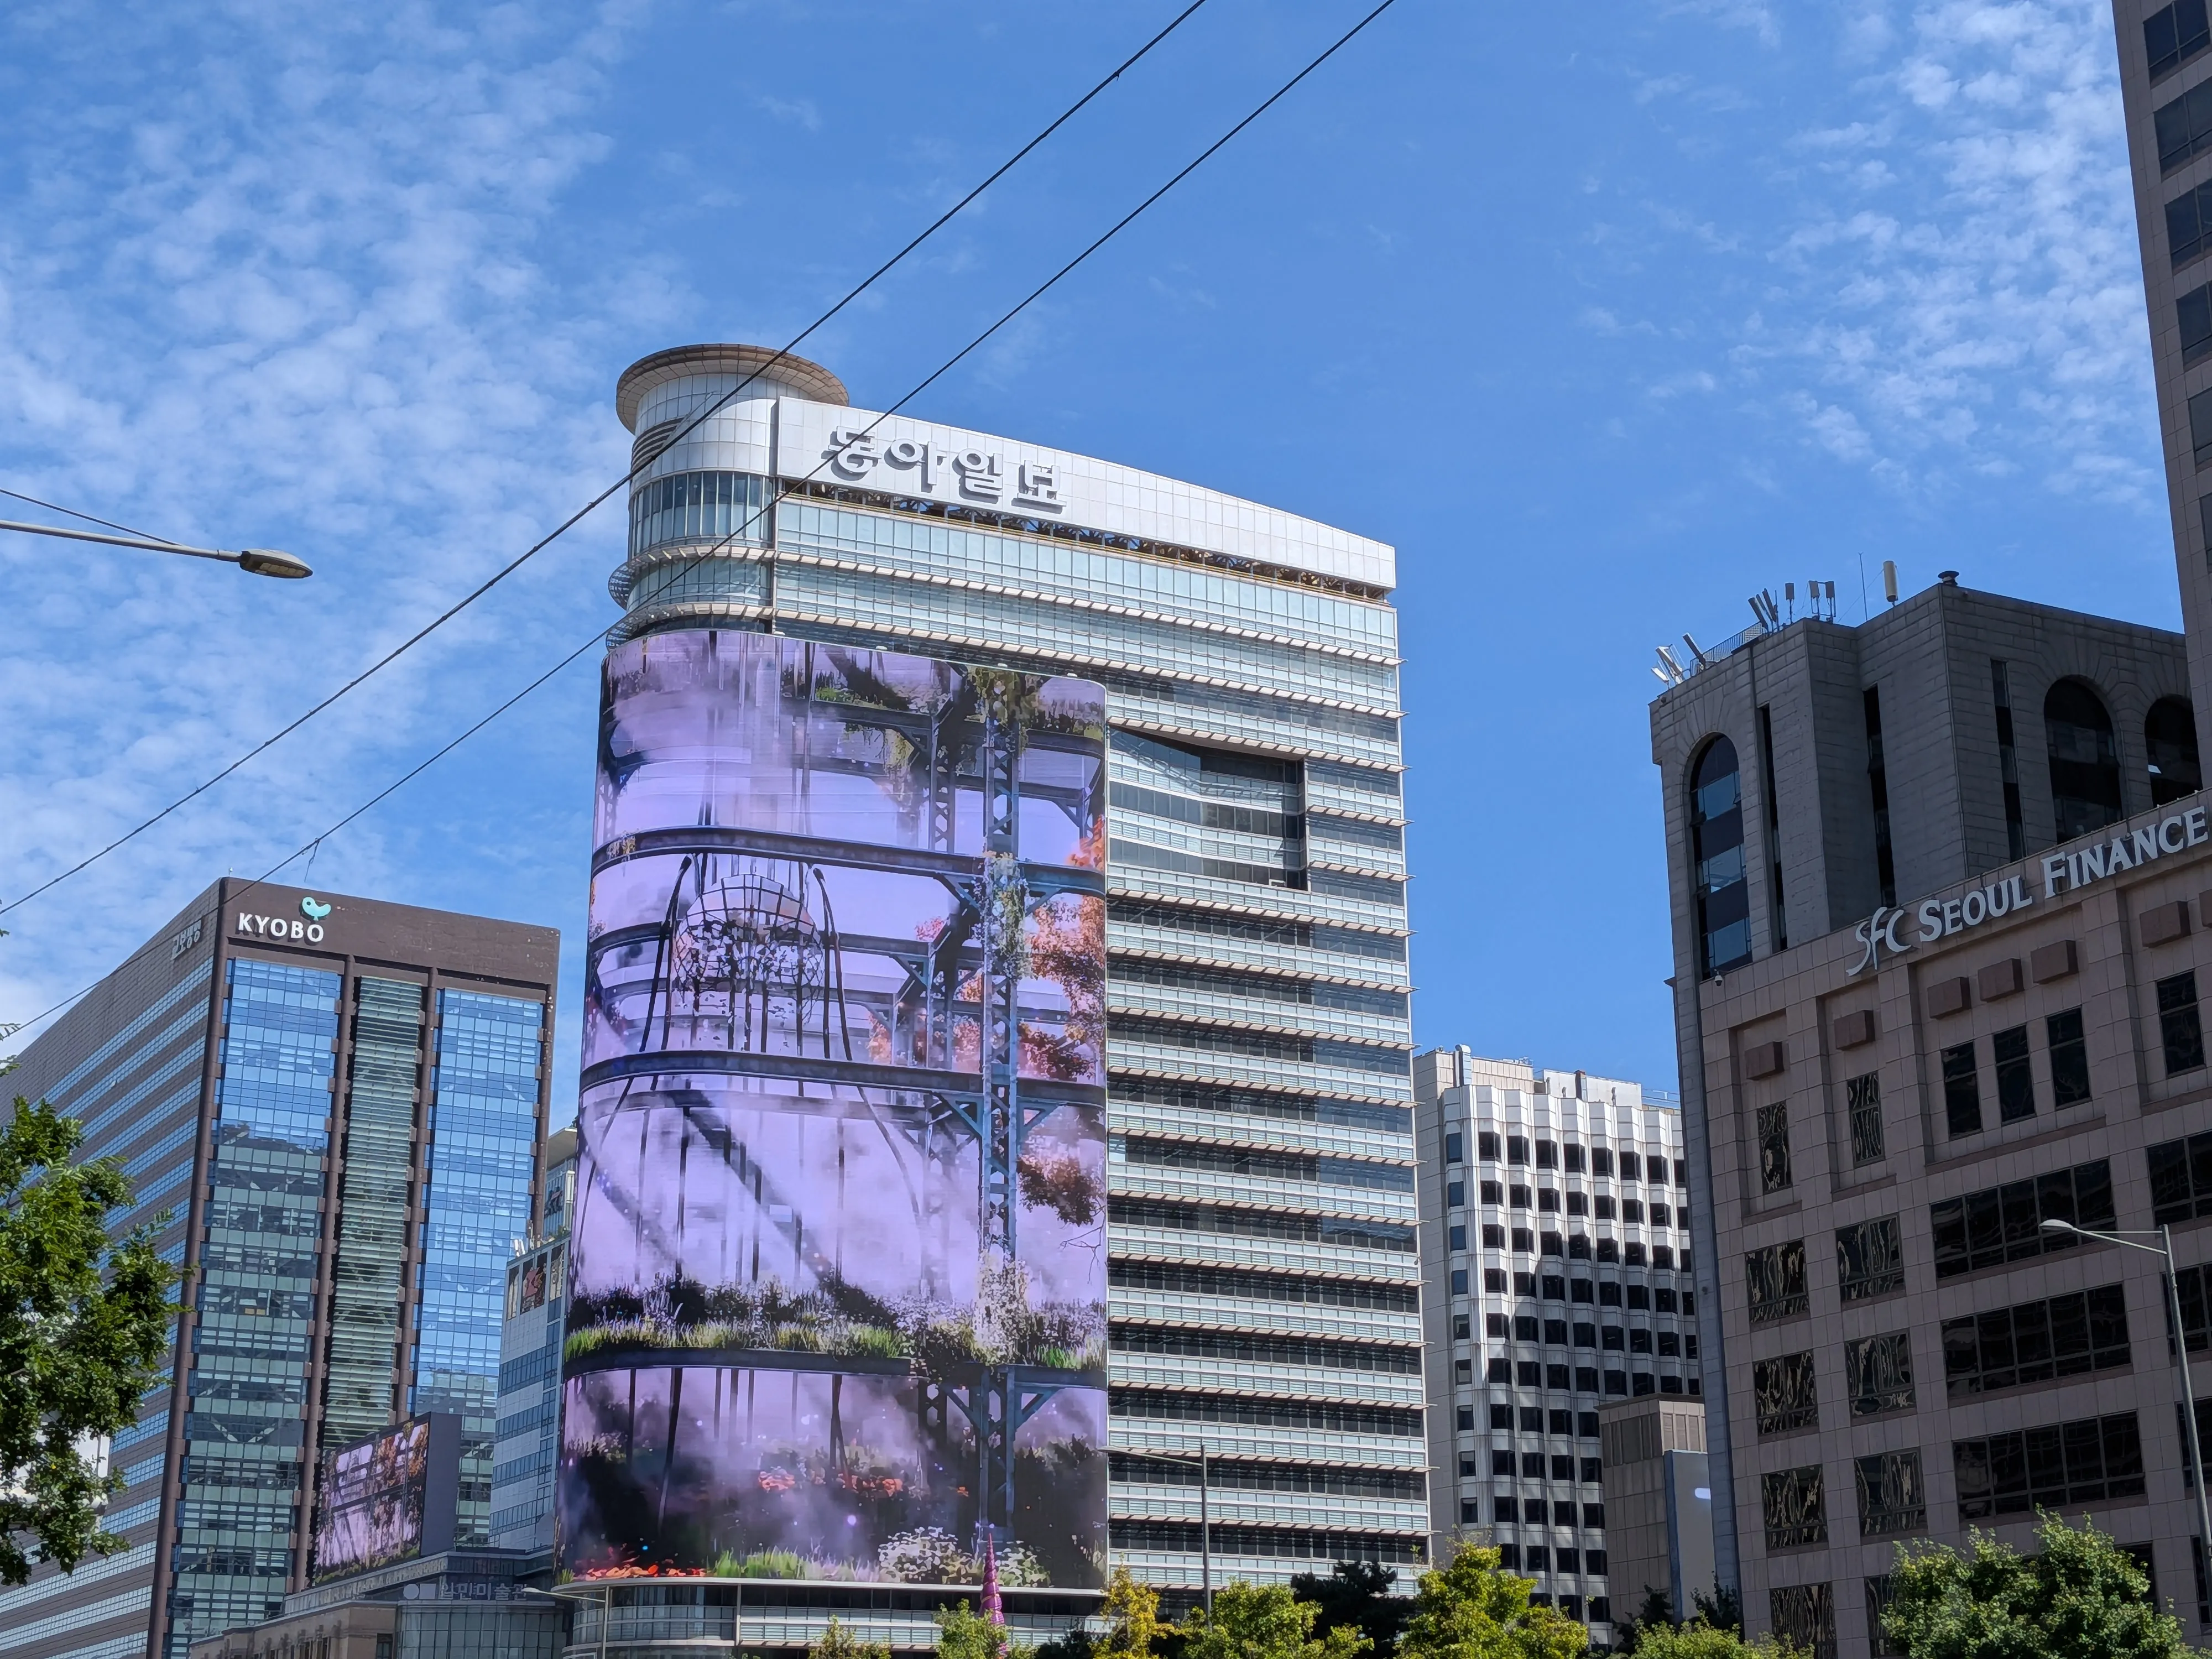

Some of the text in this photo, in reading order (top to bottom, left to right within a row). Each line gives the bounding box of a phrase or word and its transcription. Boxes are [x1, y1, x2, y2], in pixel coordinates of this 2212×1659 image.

[827, 425, 1067, 508] 동아일보
[1918, 874, 2033, 942] SEOUL
[2041, 805, 2209, 899] FINANCE
[238, 912, 325, 942] KYOBO
[442, 1582, 528, 1601] 일민미술관
